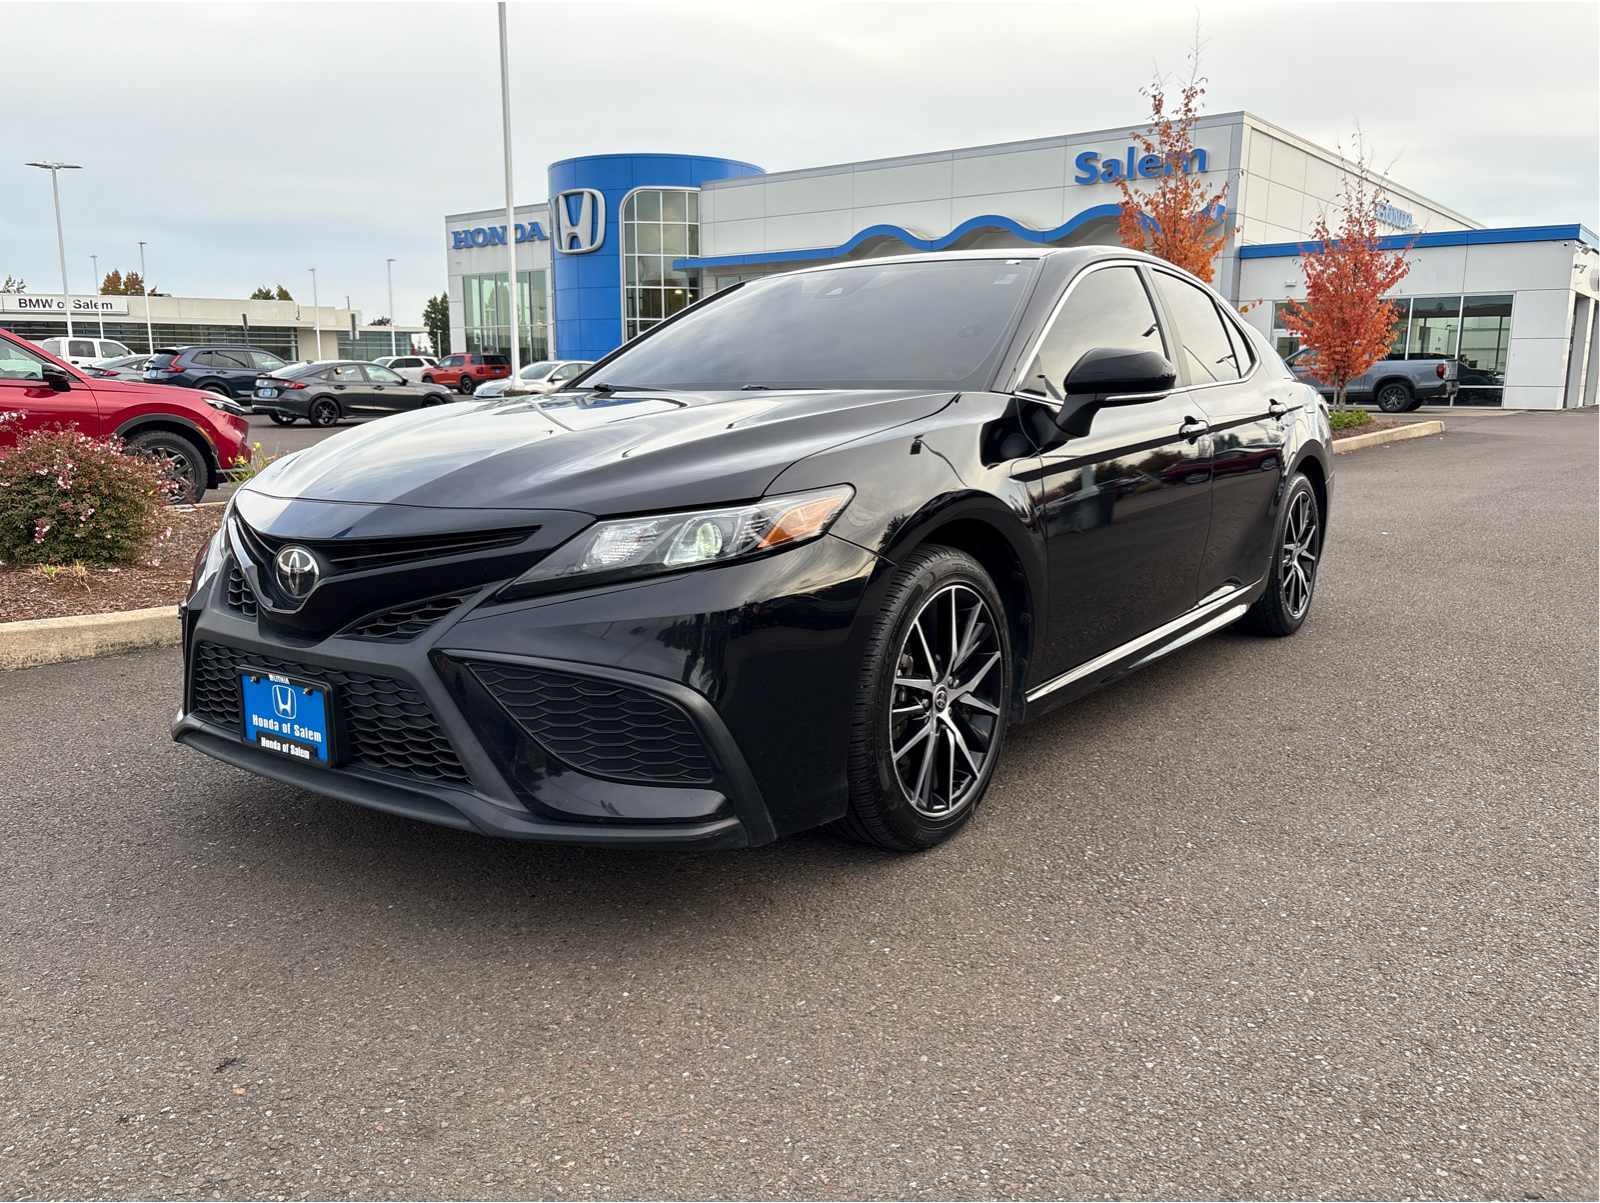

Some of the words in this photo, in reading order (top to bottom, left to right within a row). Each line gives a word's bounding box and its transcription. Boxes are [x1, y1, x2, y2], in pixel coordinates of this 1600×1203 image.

[1074, 146, 1208, 186] Salem
[451, 221, 548, 249] HONDA
[18, 298, 53, 309] BMW
[73, 299, 113, 310] Salem
[252, 714, 279, 731] Honda
[282, 723, 291, 735] of
[293, 725, 322, 742] Salem
[261, 736, 281, 751] Honda
[282, 743, 290, 753] of
[290, 744, 310, 760] Salem
